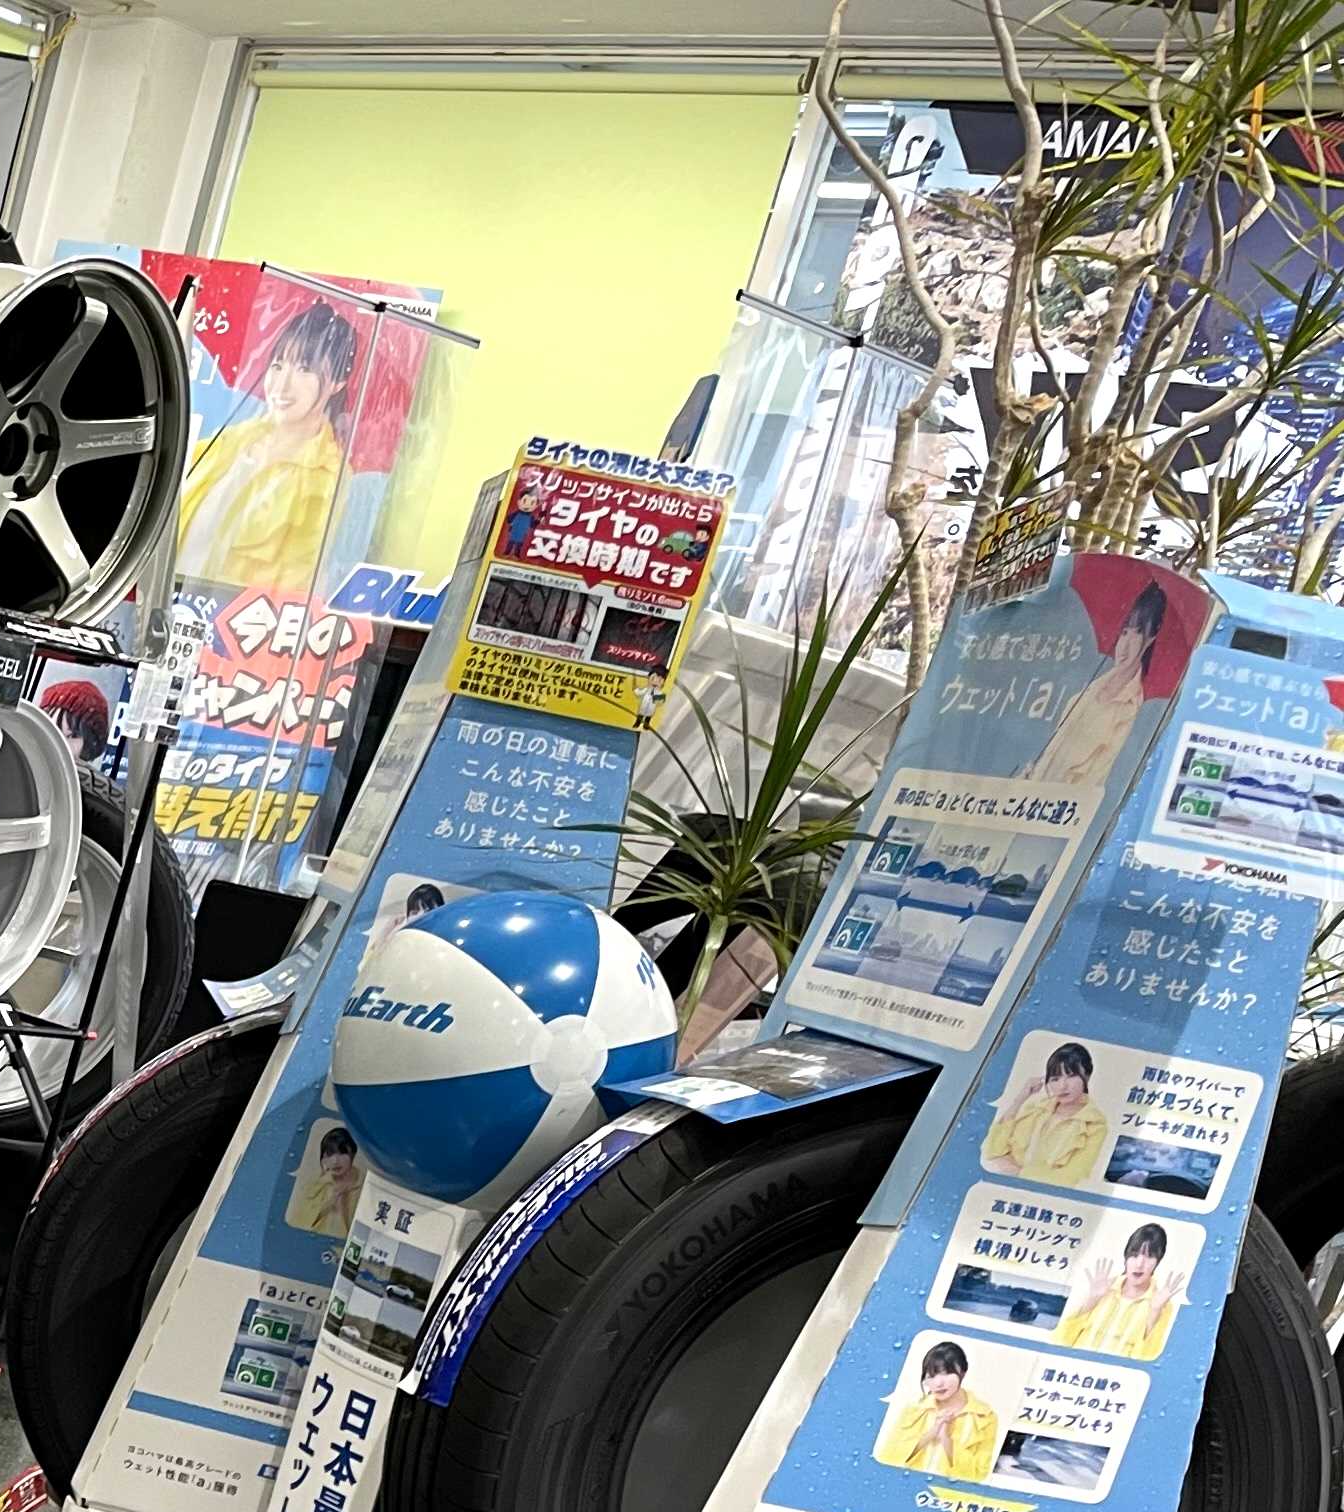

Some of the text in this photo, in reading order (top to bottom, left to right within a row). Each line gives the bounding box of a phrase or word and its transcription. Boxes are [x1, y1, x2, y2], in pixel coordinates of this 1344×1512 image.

[525, 470, 713, 523] スリップサインが出たら
[549, 499, 661, 547] タイヤの
[527, 528, 693, 589] 交換時期です
[1194, 684, 1322, 734] ウェット「a」
[457, 718, 618, 771] 雨の日の運転に
[458, 757, 598, 802] こんな不安を
[463, 789, 572, 830] 感じたこと
[1223, 861, 1289, 885] YOKOHAMA
[1118, 893, 1280, 943] こんな不安を
[1122, 929, 1250, 974] 感じたこと
[1084, 959, 1258, 1015] ありませんか？
[1141, 1063, 1247, 1099] 雨粒やワイパーで
[1126, 1084, 1241, 1125] 前が見づらくて、
[374, 1199, 416, 1235] 実証
[980, 1217, 1082, 1250] コーナリングで
[991, 1198, 1084, 1230] 高速道路での
[973, 1237, 1072, 1272] 横滑りしそう
[1018, 1406, 1115, 1436] スリップしそう
[1023, 1386, 1127, 1415] マンホールの上で
